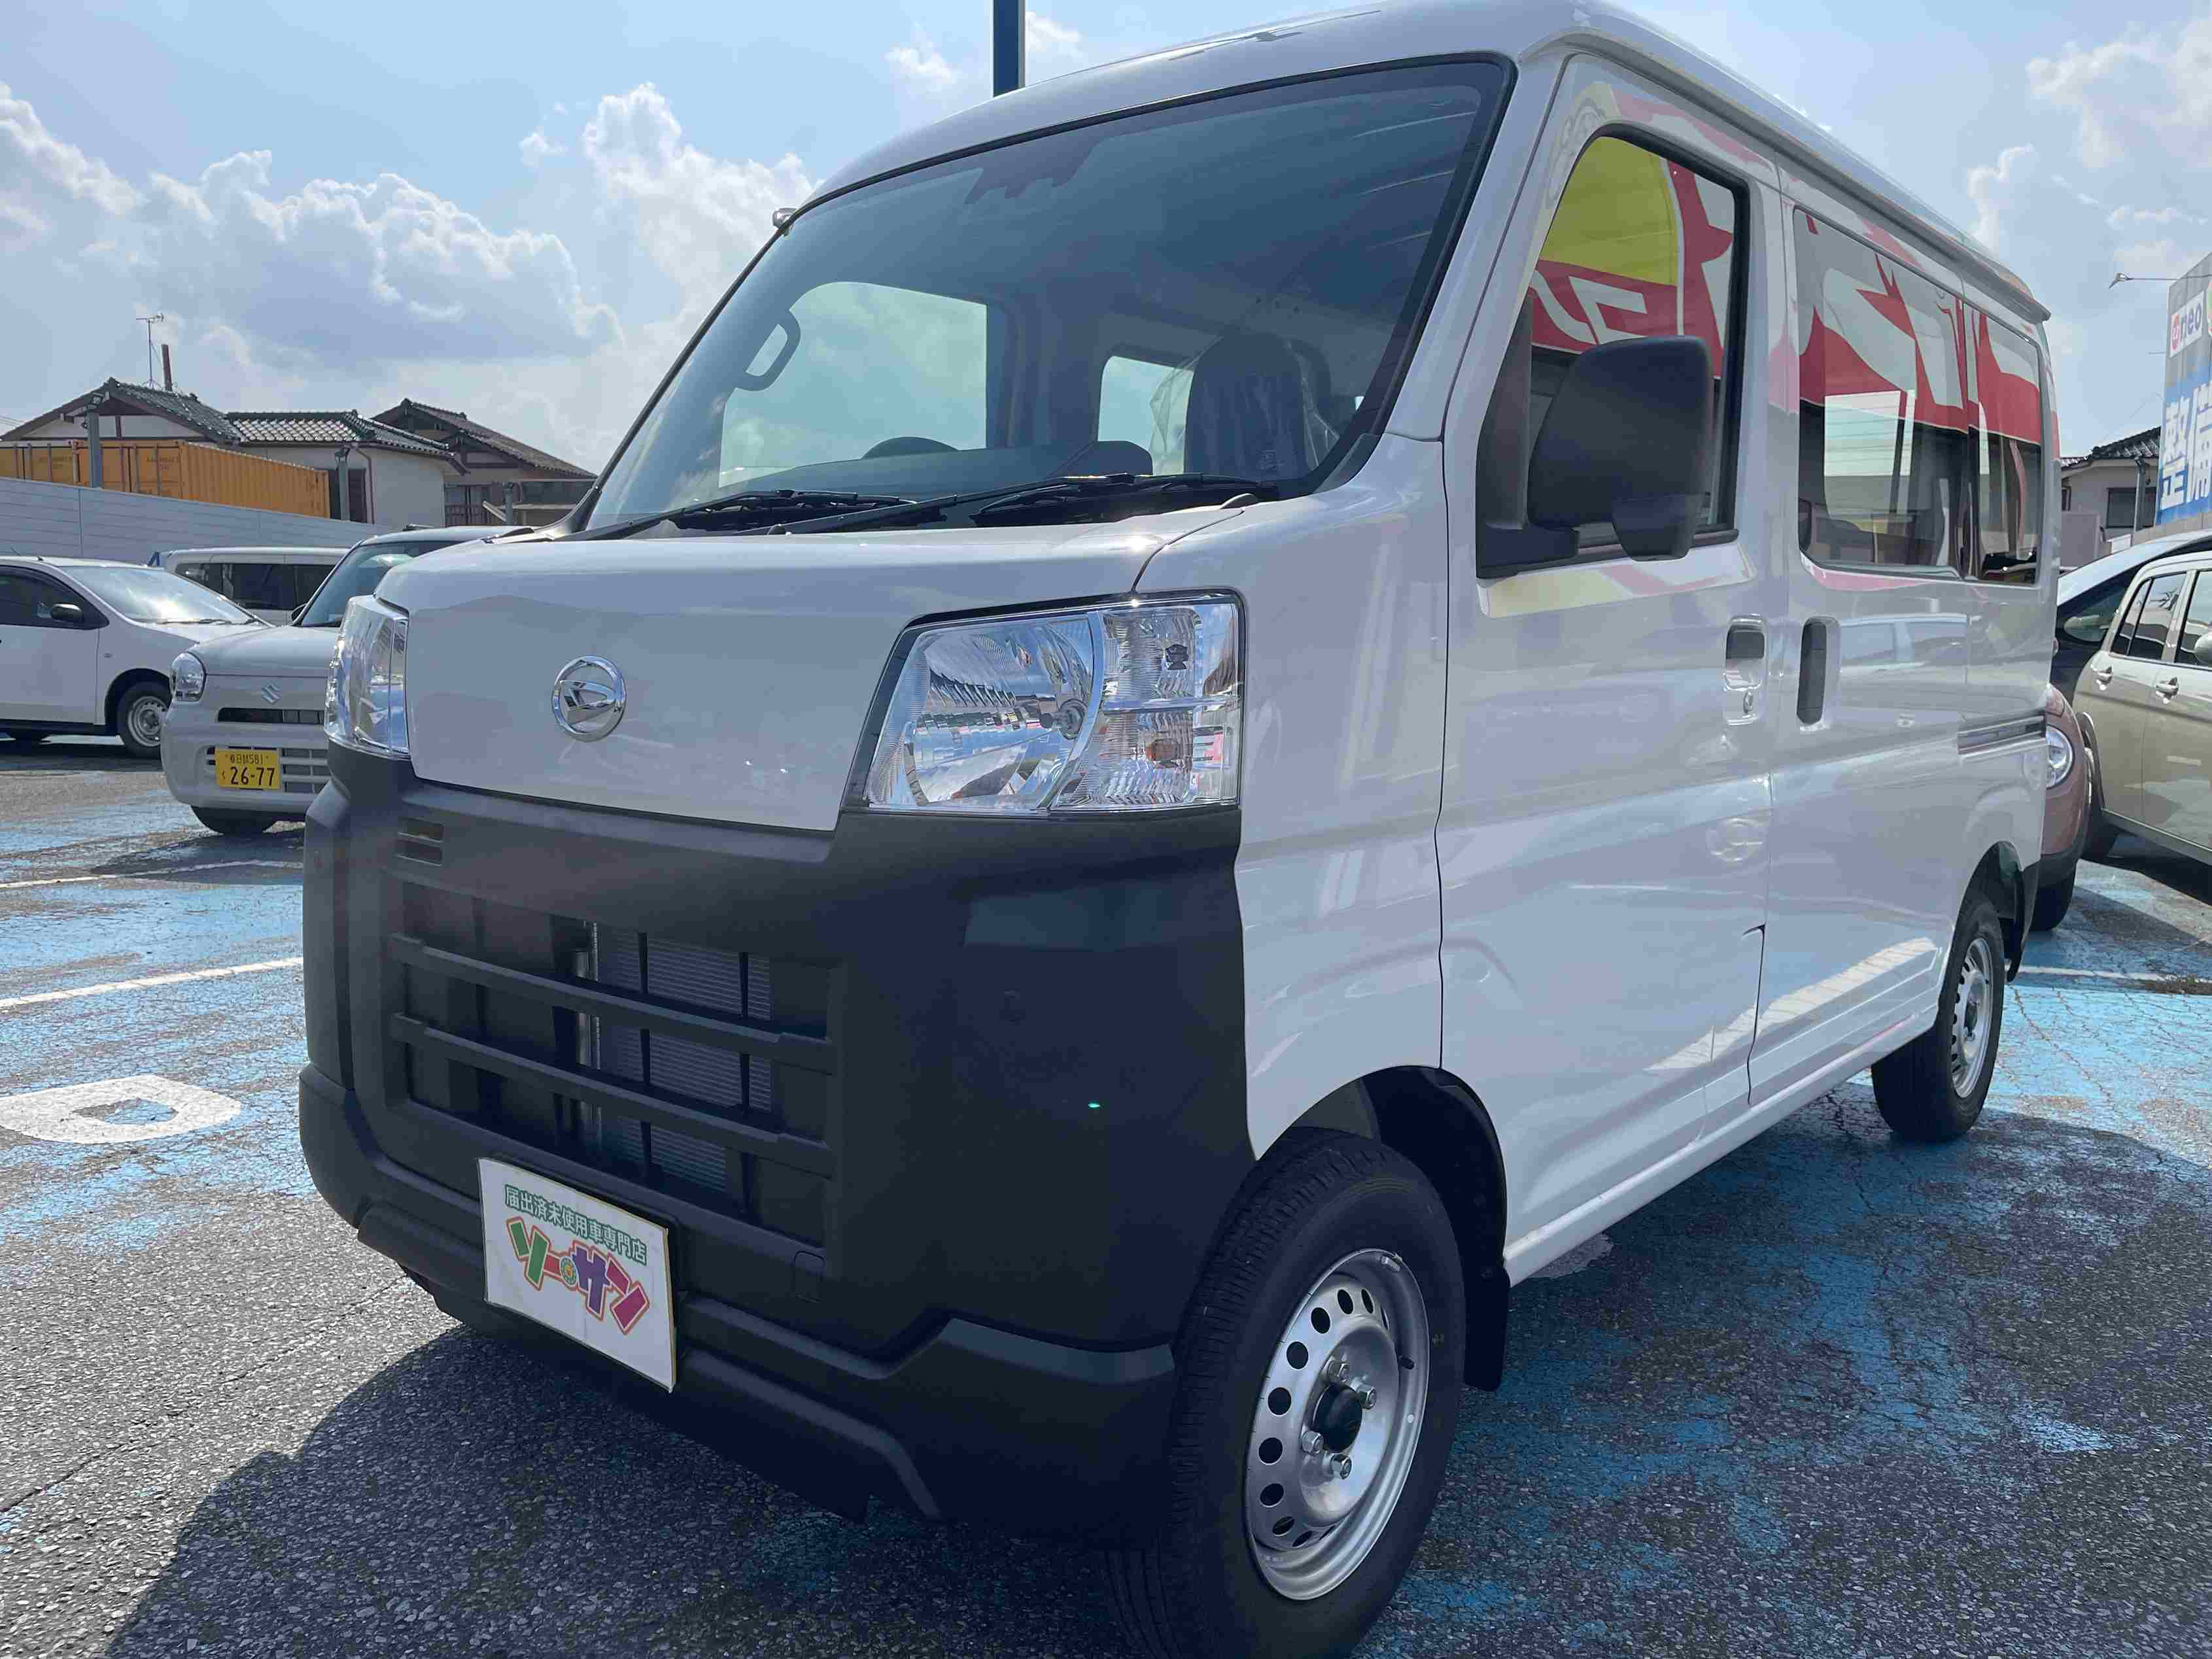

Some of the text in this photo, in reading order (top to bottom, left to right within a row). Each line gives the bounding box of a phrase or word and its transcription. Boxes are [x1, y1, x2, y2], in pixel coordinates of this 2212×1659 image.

[230, 766, 275, 786] 26-77
[504, 1184, 647, 1266] 届出済未使用車専門店
